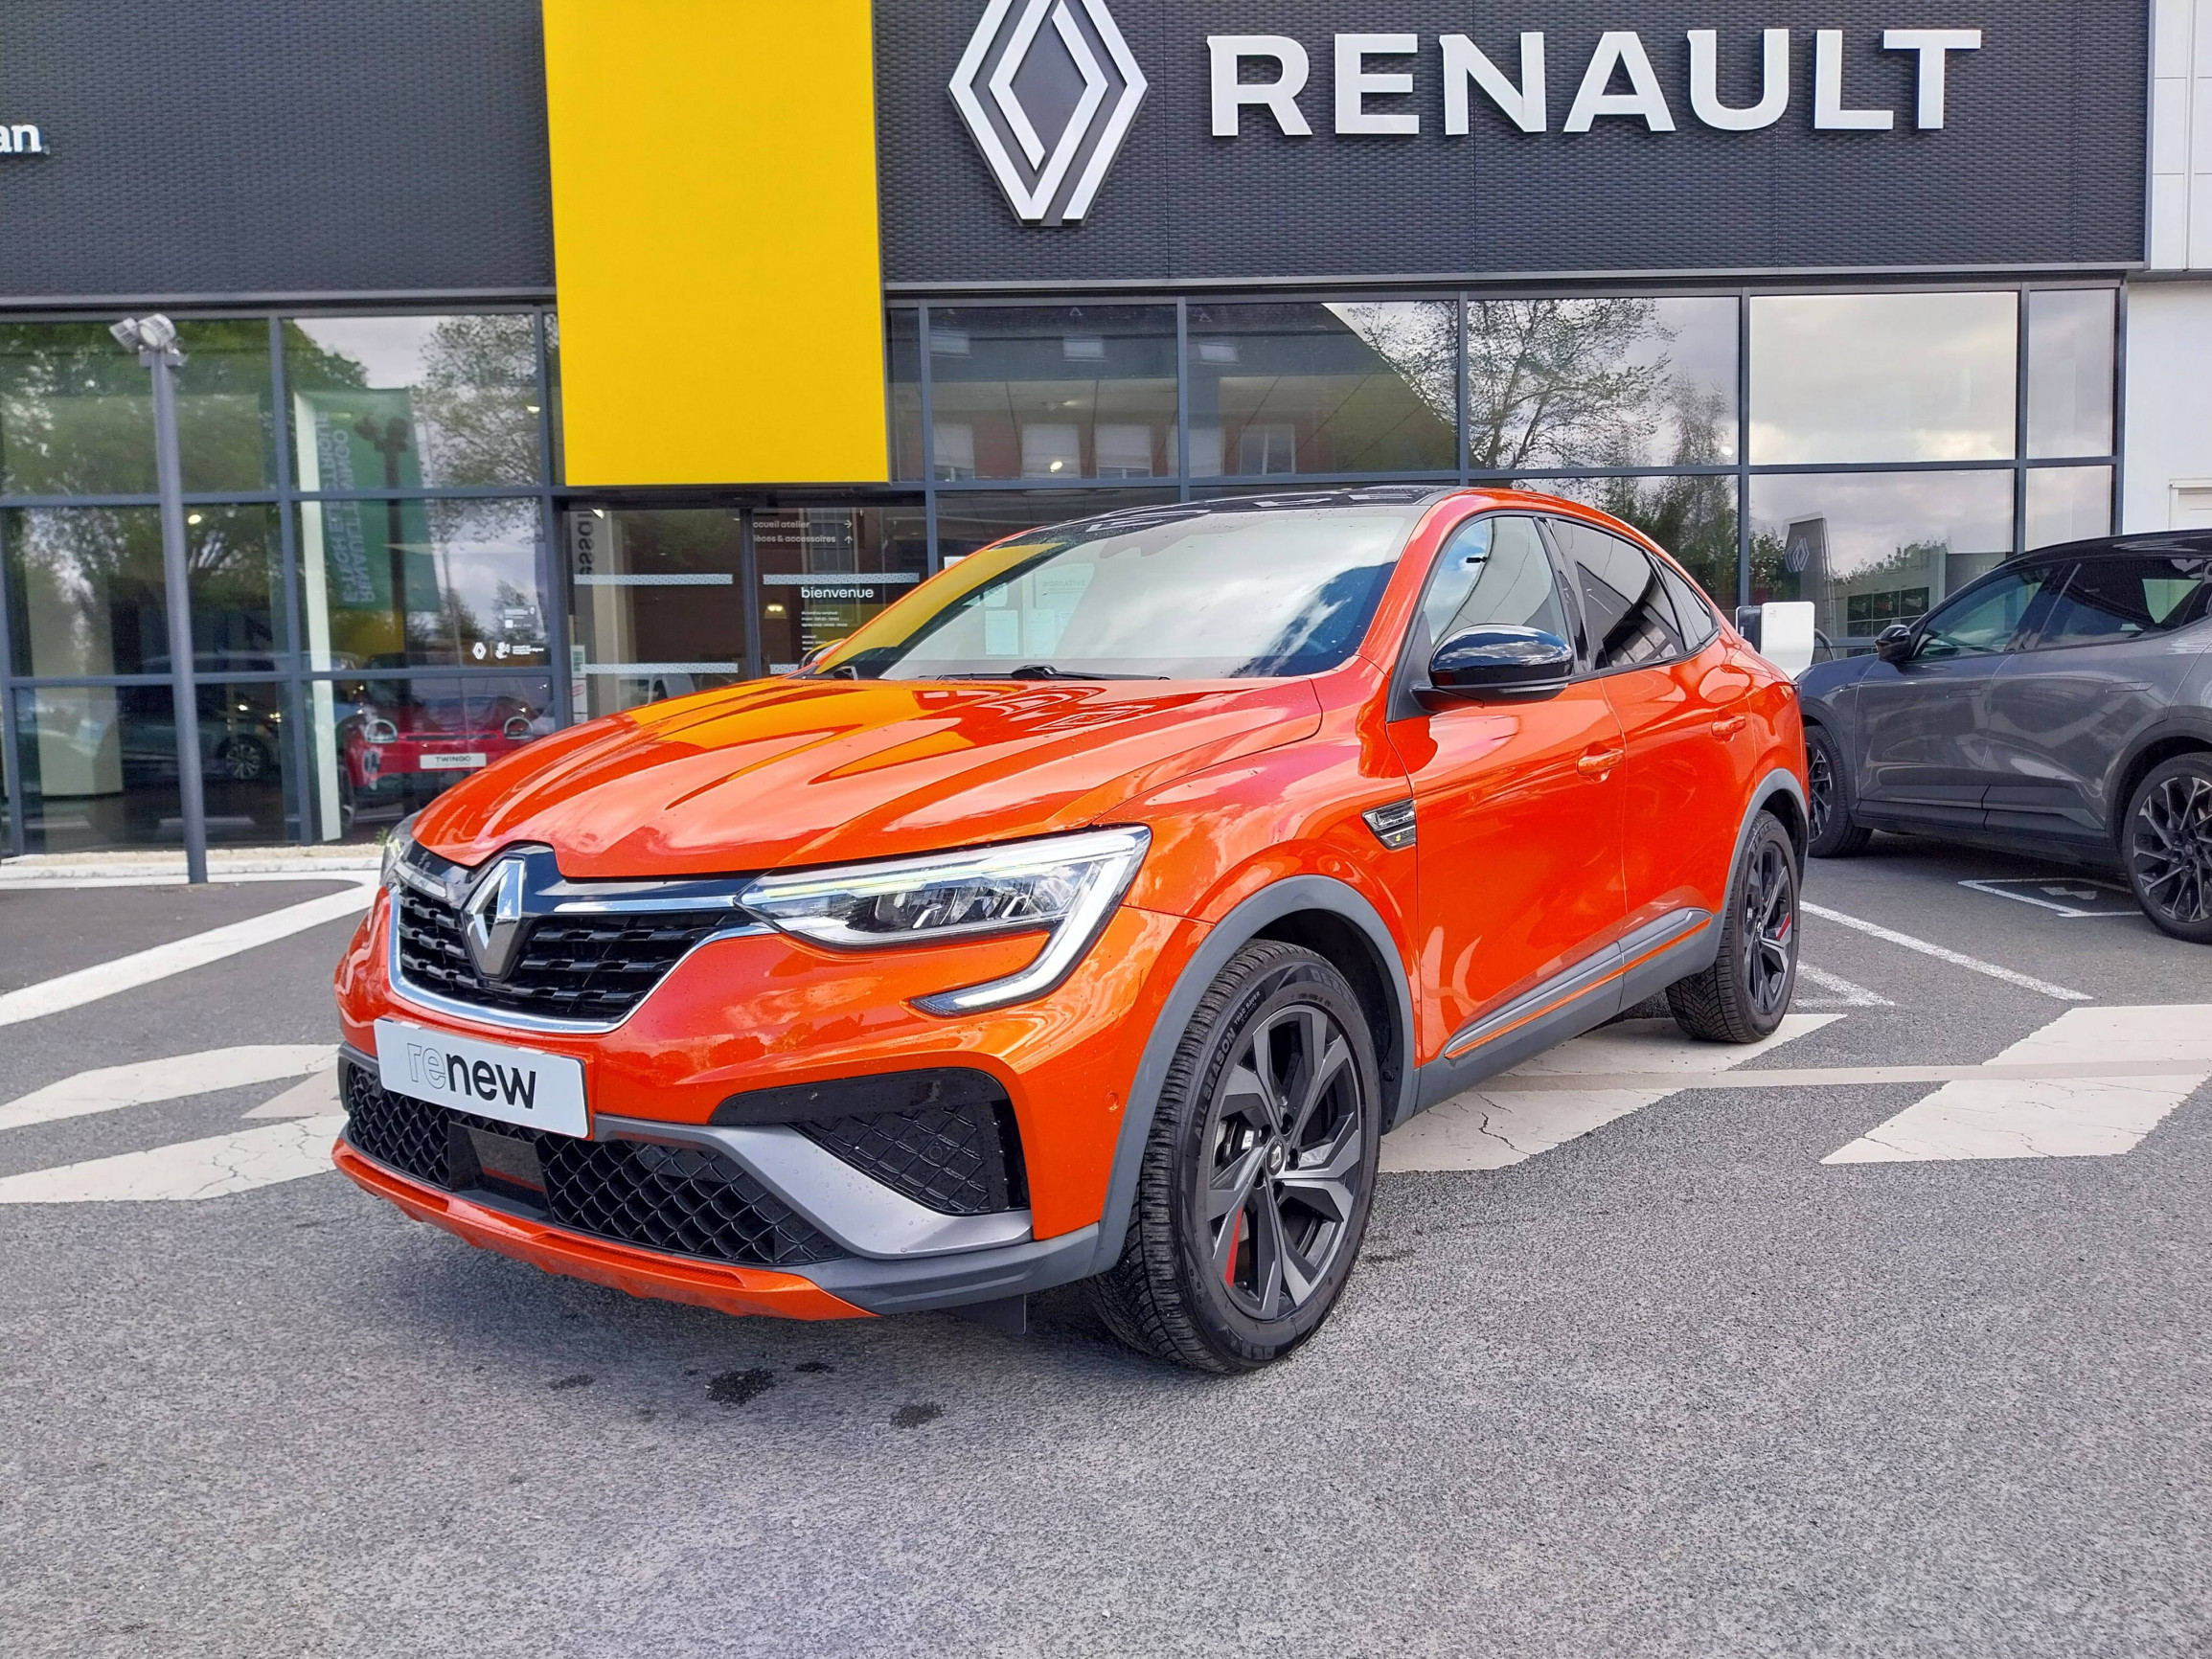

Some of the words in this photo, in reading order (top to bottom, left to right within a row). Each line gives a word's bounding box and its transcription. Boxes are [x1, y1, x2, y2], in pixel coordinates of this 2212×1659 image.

[1206, 28, 1982, 137] RENAULT
[753, 520, 780, 529] ccueil
[781, 520, 810, 529] atelier
[777, 534, 785, 543] &
[786, 534, 836, 543] accessoires
[801, 586, 874, 599] bienvenue
[435, 755, 471, 763] TWINGO
[1203, 1027, 1236, 1101] SEASON
[406, 1041, 536, 1111] renew
